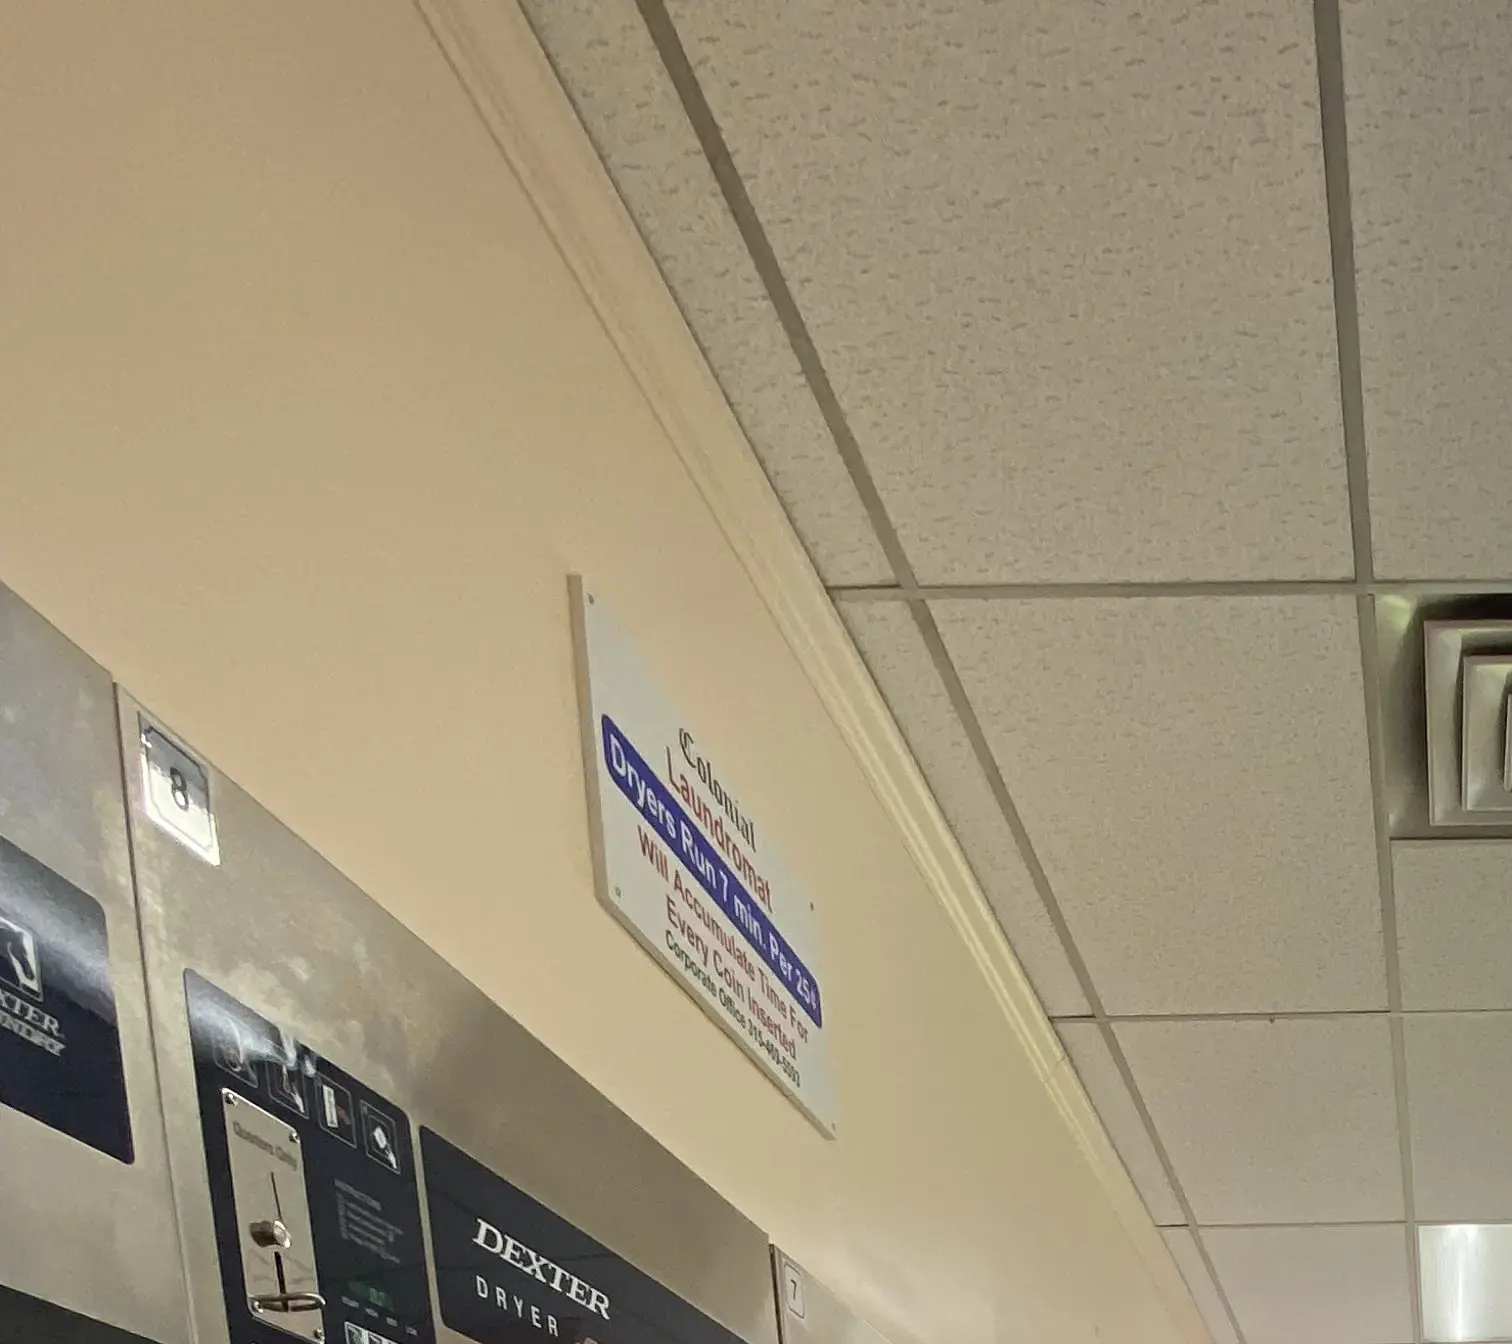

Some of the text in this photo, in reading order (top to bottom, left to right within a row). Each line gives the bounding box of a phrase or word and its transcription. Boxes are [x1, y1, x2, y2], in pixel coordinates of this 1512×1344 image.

[170, 766, 190, 811] 8
[667, 745, 773, 914] Laundromat
[679, 727, 757, 853] Colonial
[610, 733, 677, 839] Dryers
[680, 819, 717, 890] Run
[719, 868, 729, 902] 7
[733, 894, 767, 949] min.
[769, 932, 793, 980] Per
[637, 824, 810, 1044] Will Accumulate Time For
[665, 929, 717, 999] Corporate
[718, 987, 747, 1029] Office
[666, 893, 797, 1061] Every Coin Inserted
[0, 987, 61, 1037] XTER
[471, 1217, 611, 1321] DEXTER
[475, 1274, 559, 1338] DRYER
[789, 1279, 798, 1302] 7
